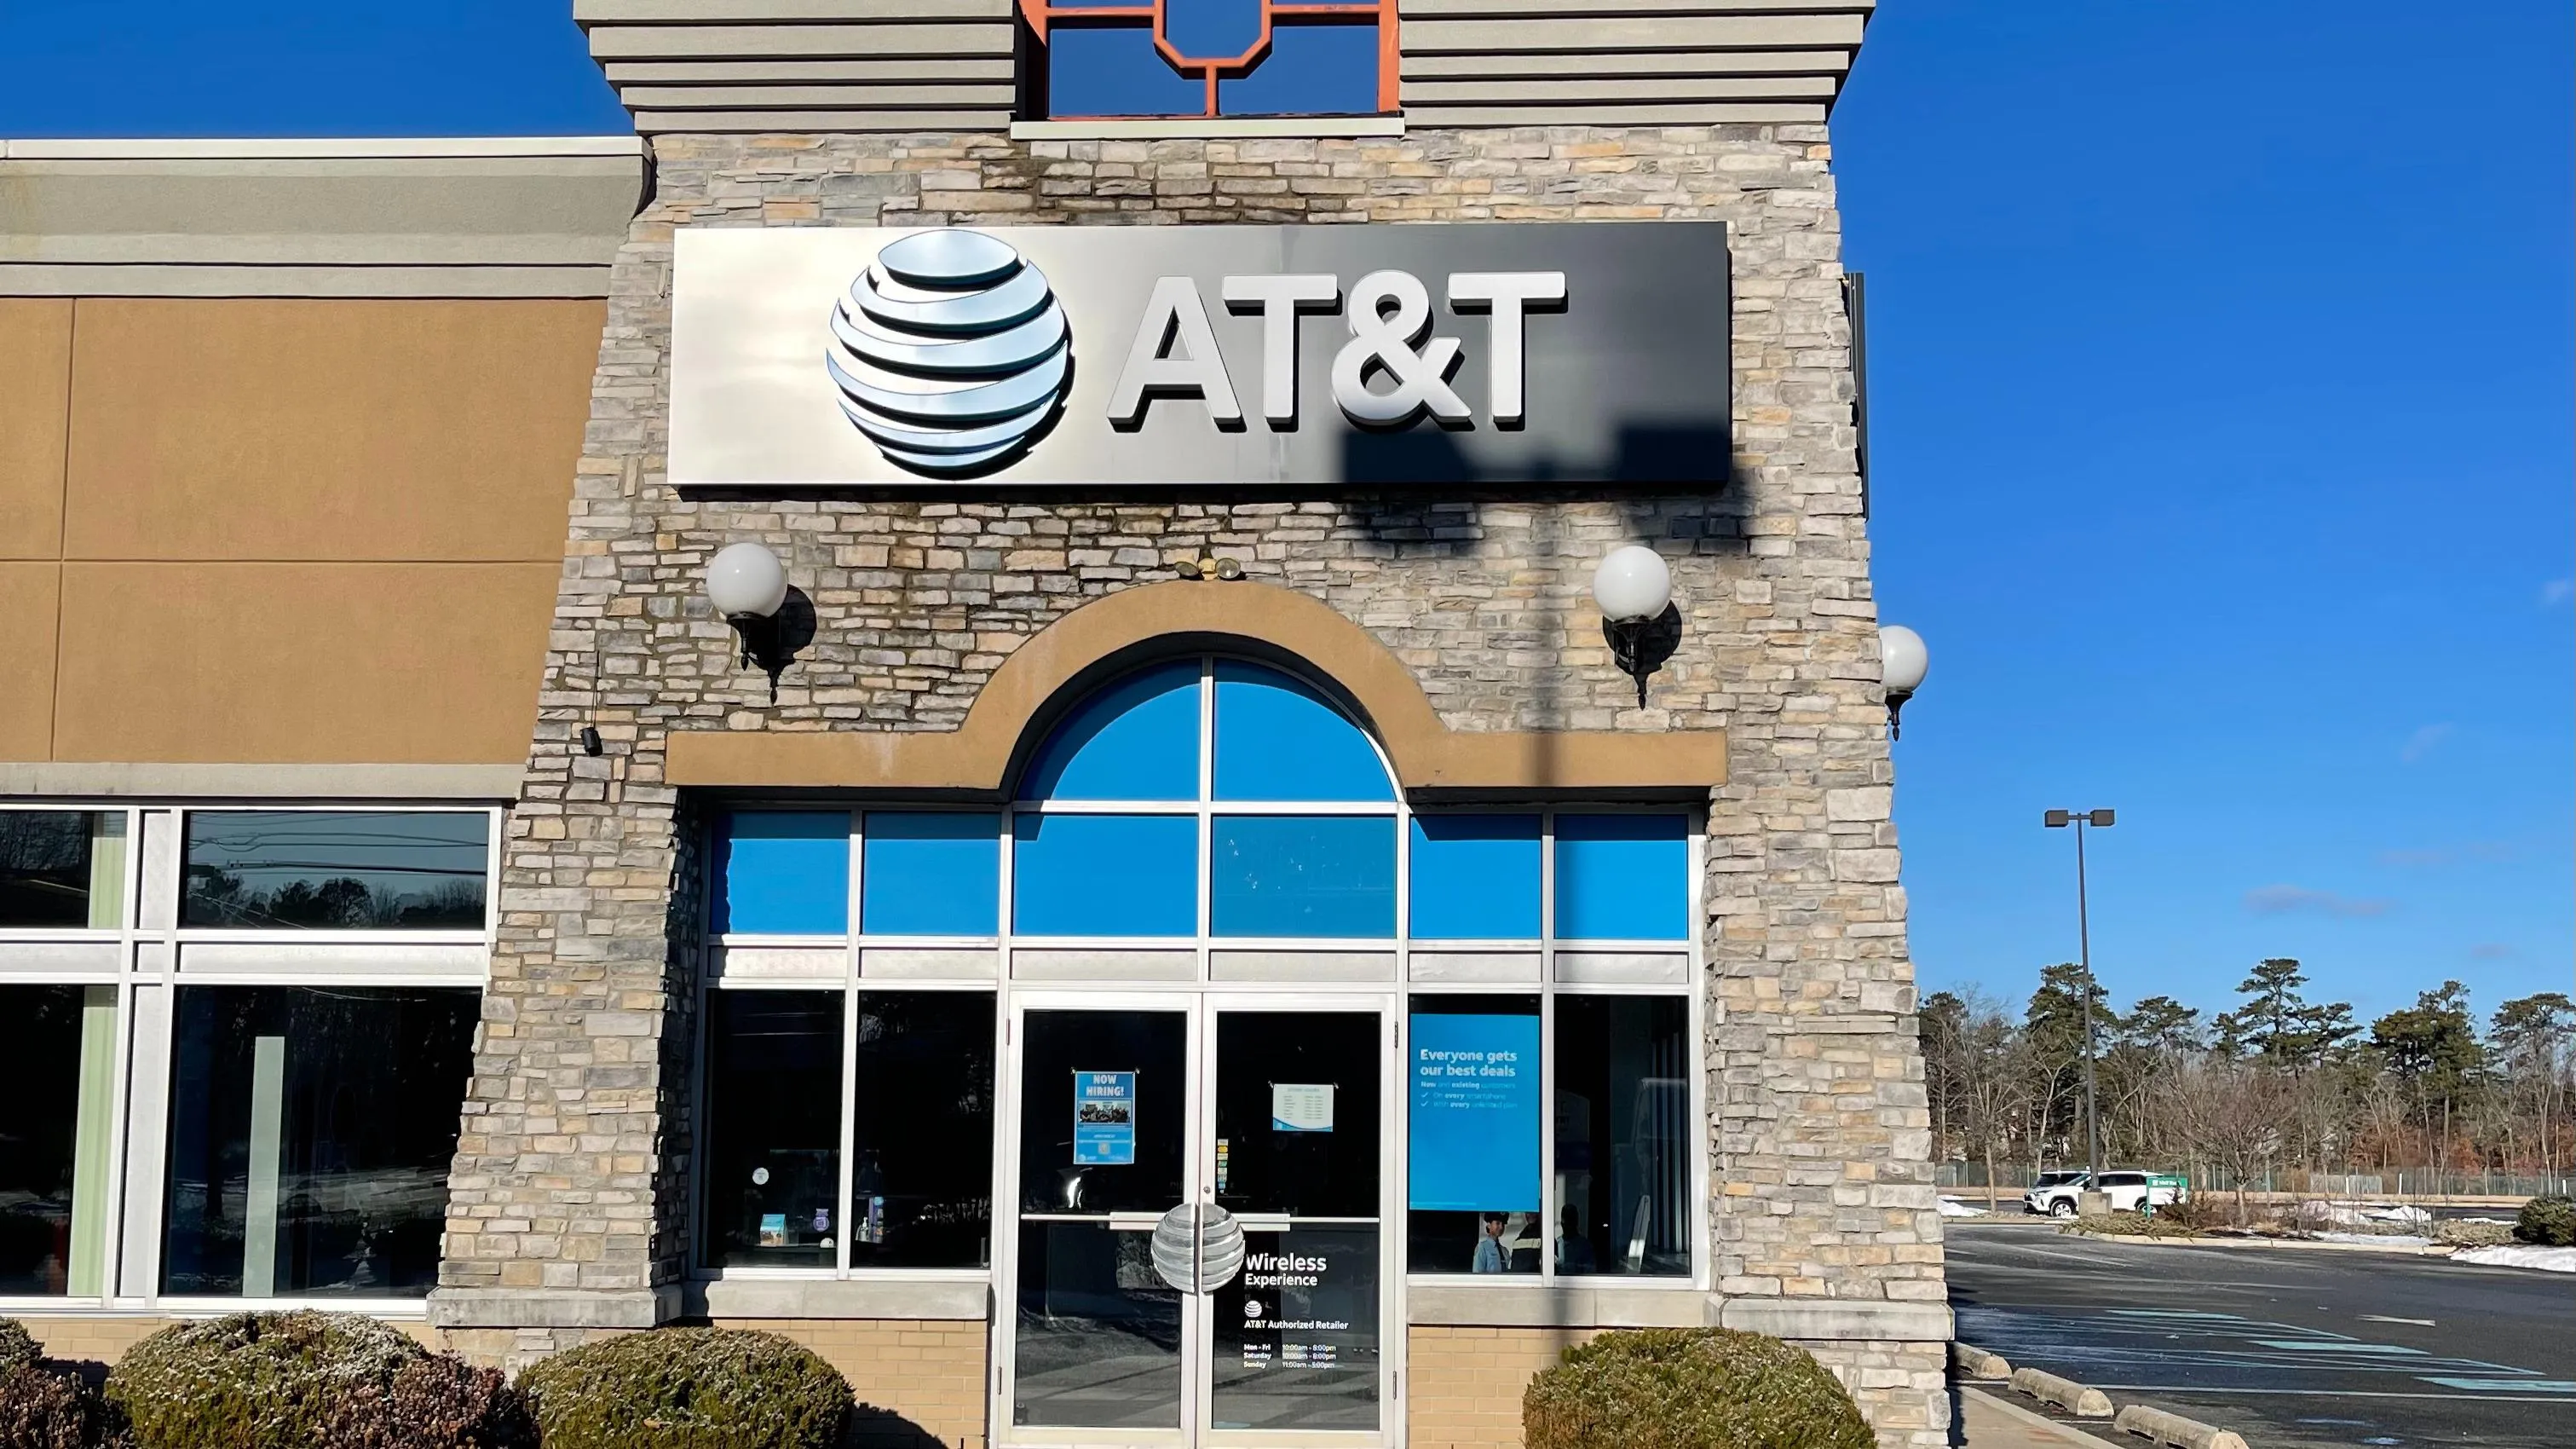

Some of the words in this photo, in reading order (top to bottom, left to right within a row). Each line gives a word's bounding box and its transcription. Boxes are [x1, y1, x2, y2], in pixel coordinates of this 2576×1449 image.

[1106, 268, 1568, 426] AT&T
[1420, 1048, 1484, 1064] Everyone
[1487, 1051, 1518, 1064] gets
[1420, 1066, 1444, 1077] our
[1446, 1064, 1477, 1077] best
[1479, 1065, 1516, 1077] deals
[1093, 1074, 1117, 1085] NOW
[1451, 1081, 1480, 1090] existing
[1086, 1086, 1125, 1097] HIRING!
[1245, 1253, 1328, 1272] Wireless
[1244, 1273, 1318, 1288] Experience
[1243, 1320, 1267, 1330] AT&T
[1268, 1320, 1315, 1330] Authorized
[1316, 1320, 1349, 1331] Retailer
[1243, 1352, 1272, 1360] Saturday
